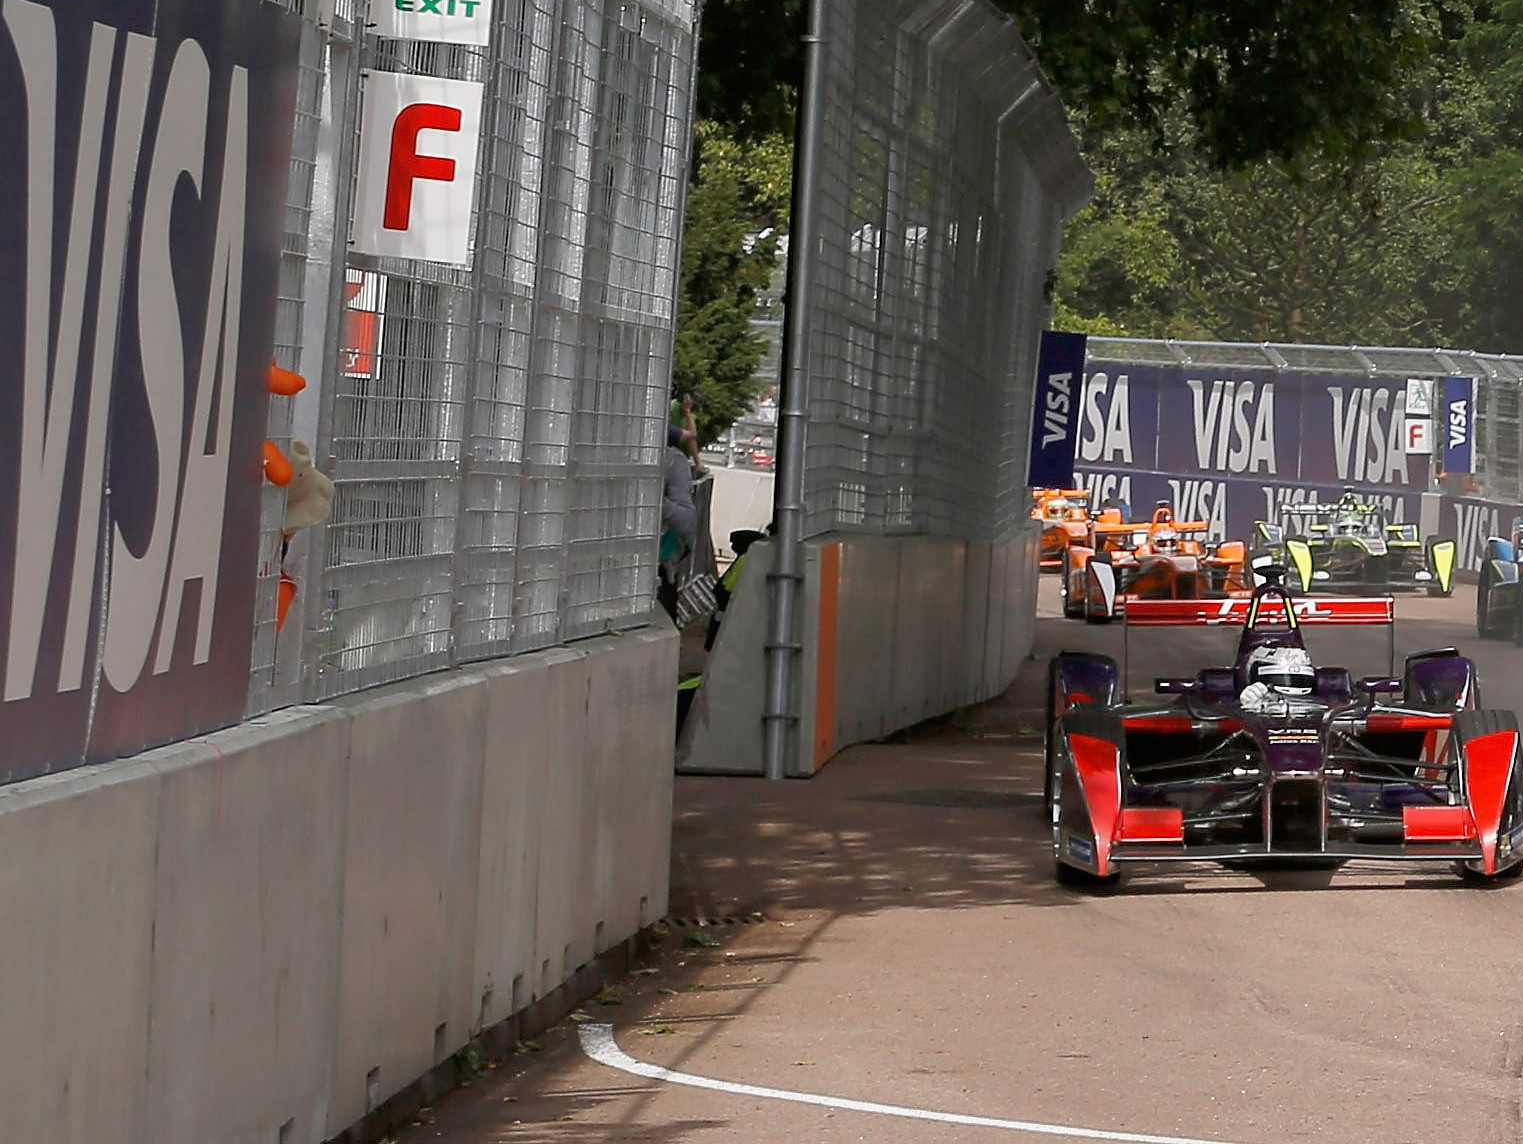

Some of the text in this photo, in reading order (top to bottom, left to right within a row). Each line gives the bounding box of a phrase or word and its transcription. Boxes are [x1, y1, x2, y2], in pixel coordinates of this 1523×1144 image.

[383, 102, 463, 231] F
[1041, 372, 1073, 450] VISA
[1187, 379, 1277, 475] VISA
[1327, 386, 1409, 485] VISA
[1409, 424, 1424, 448] F
[1450, 399, 1467, 450] VISA
[1168, 479, 1227, 545] VISA
